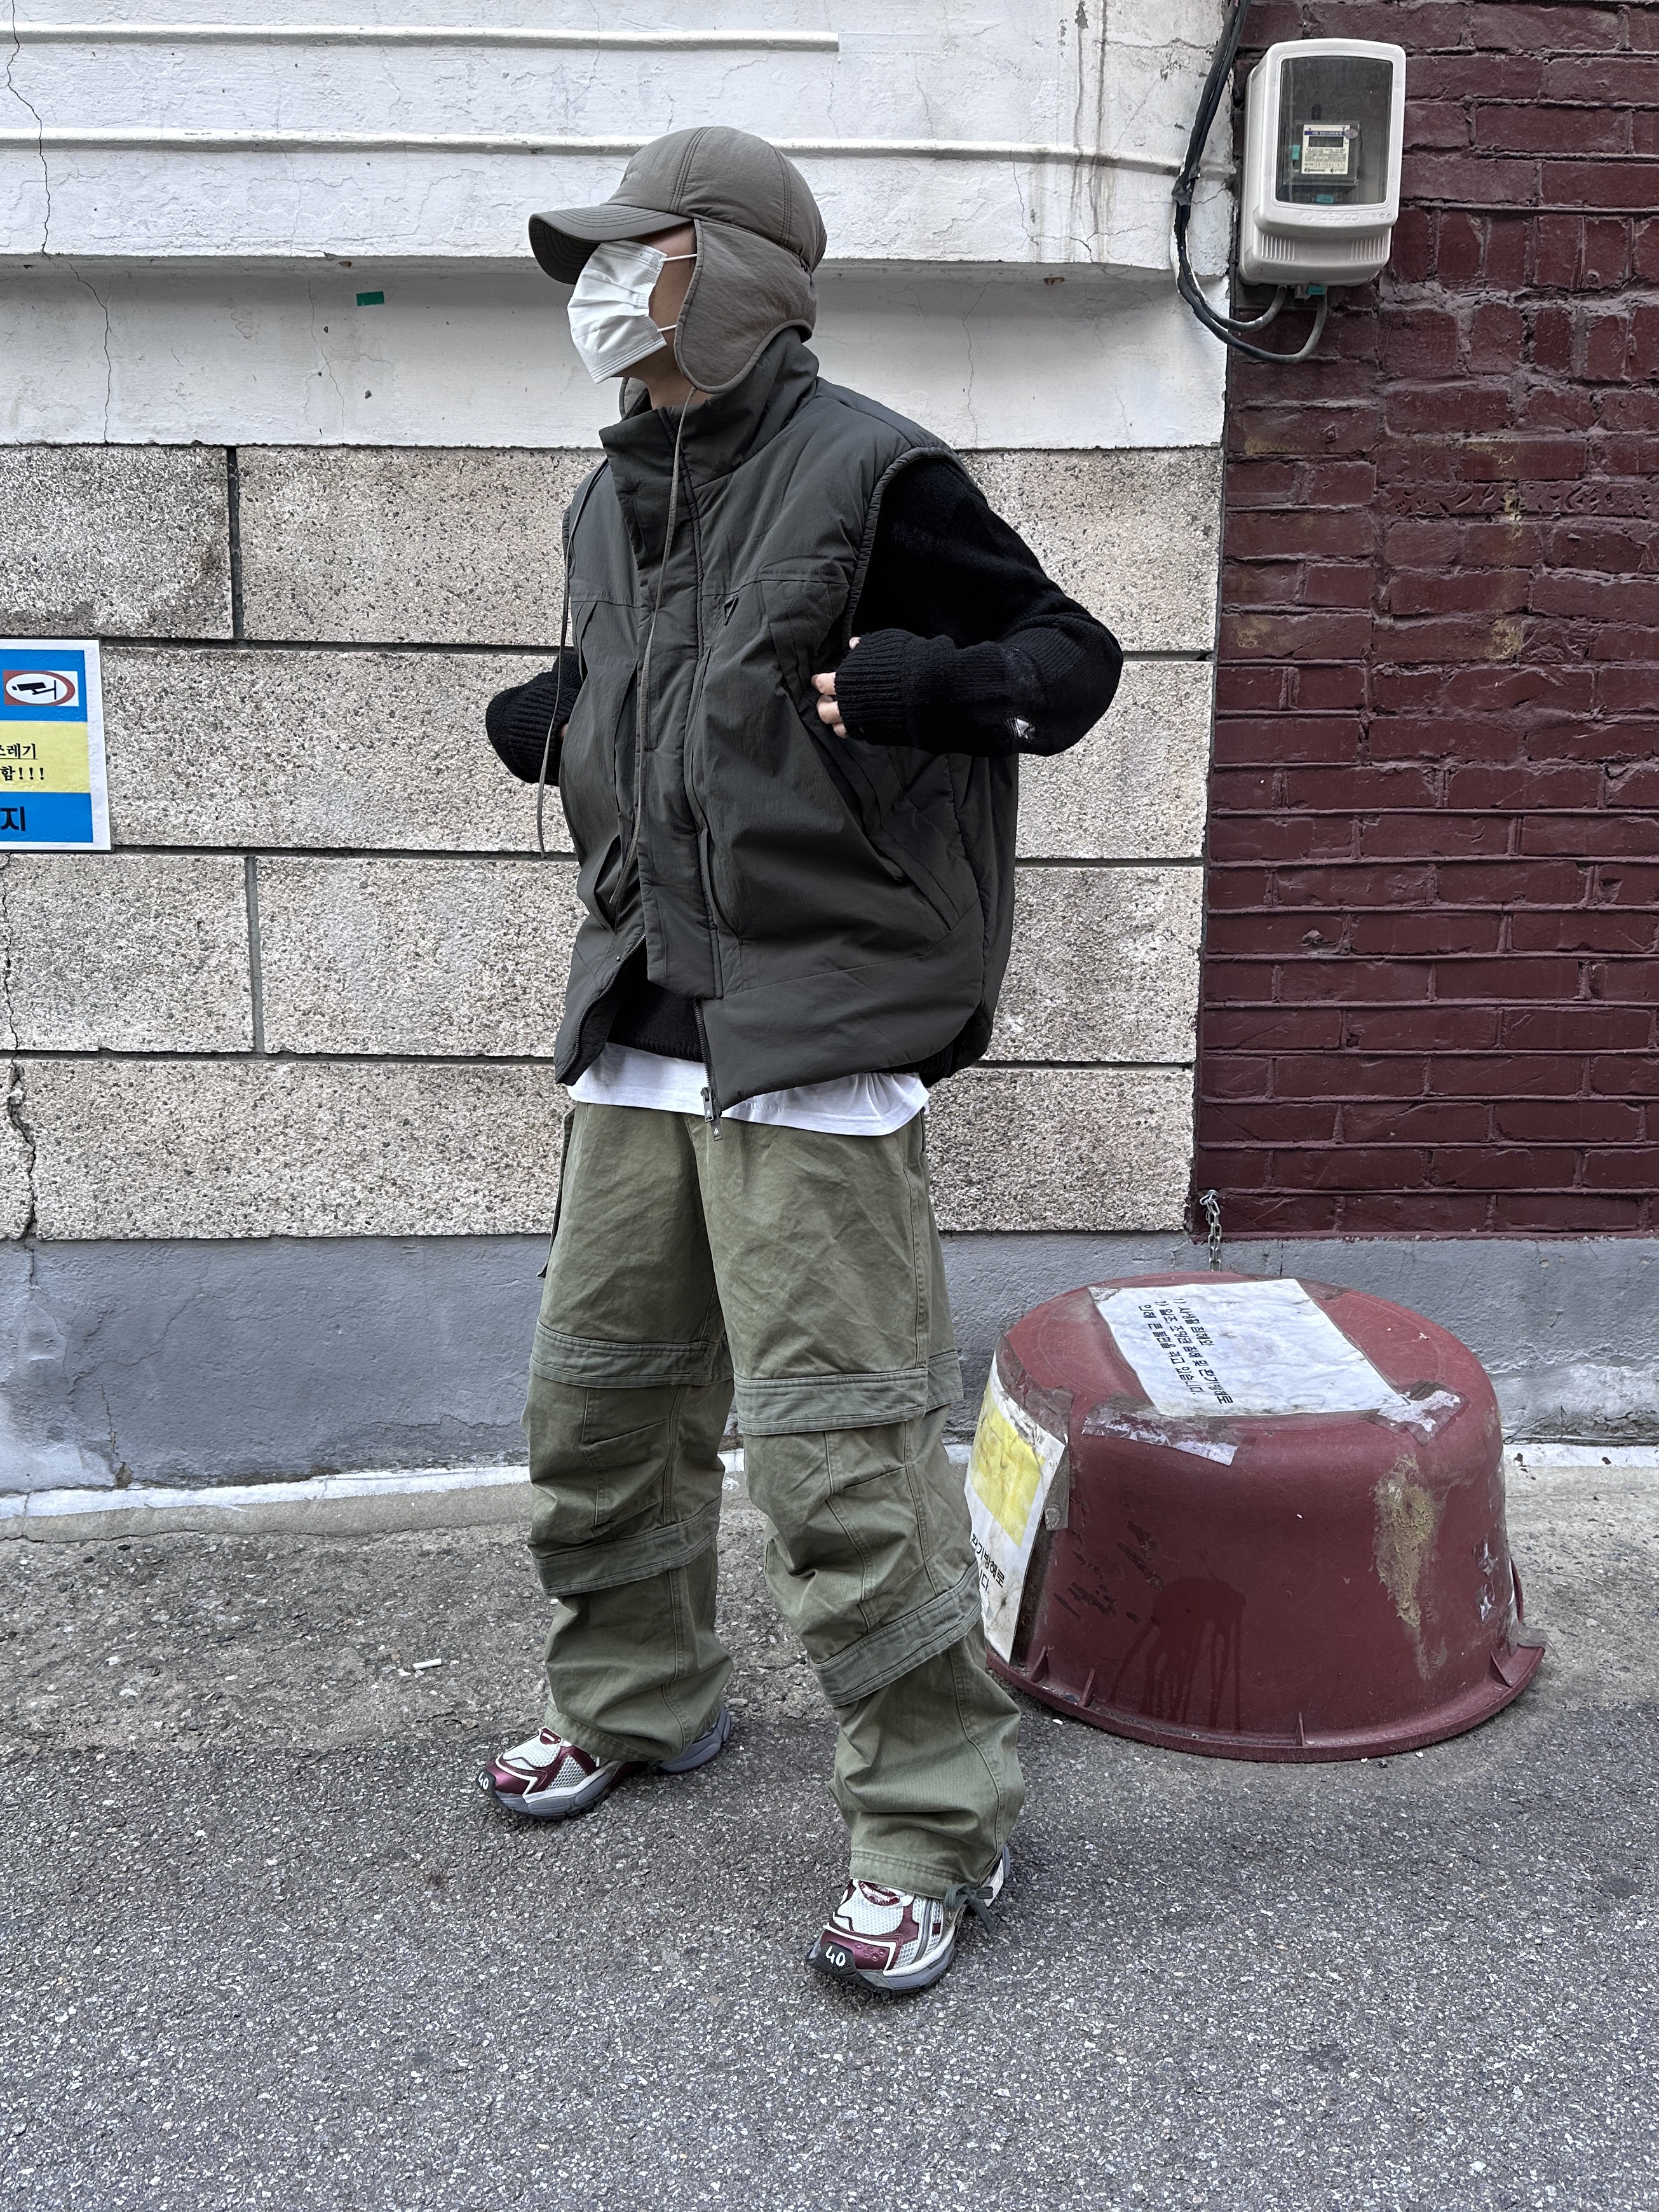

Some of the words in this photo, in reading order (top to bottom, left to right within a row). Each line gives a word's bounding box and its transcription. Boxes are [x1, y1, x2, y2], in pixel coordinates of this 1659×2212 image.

[0, 766, 44, 782] 함!!!
[0, 806, 26, 832] 지
[1138, 1305, 1158, 1319] 인해
[1152, 1331, 1177, 1349] 불편을
[1178, 1306, 1201, 1325] 사생활
[1190, 1326, 1216, 1347] 침해와
[1182, 1346, 1204, 1358] 침해
[1198, 1369, 1234, 1404] 환기방해로
[478, 1772, 489, 1790] 40
[825, 1945, 846, 1967] 40
